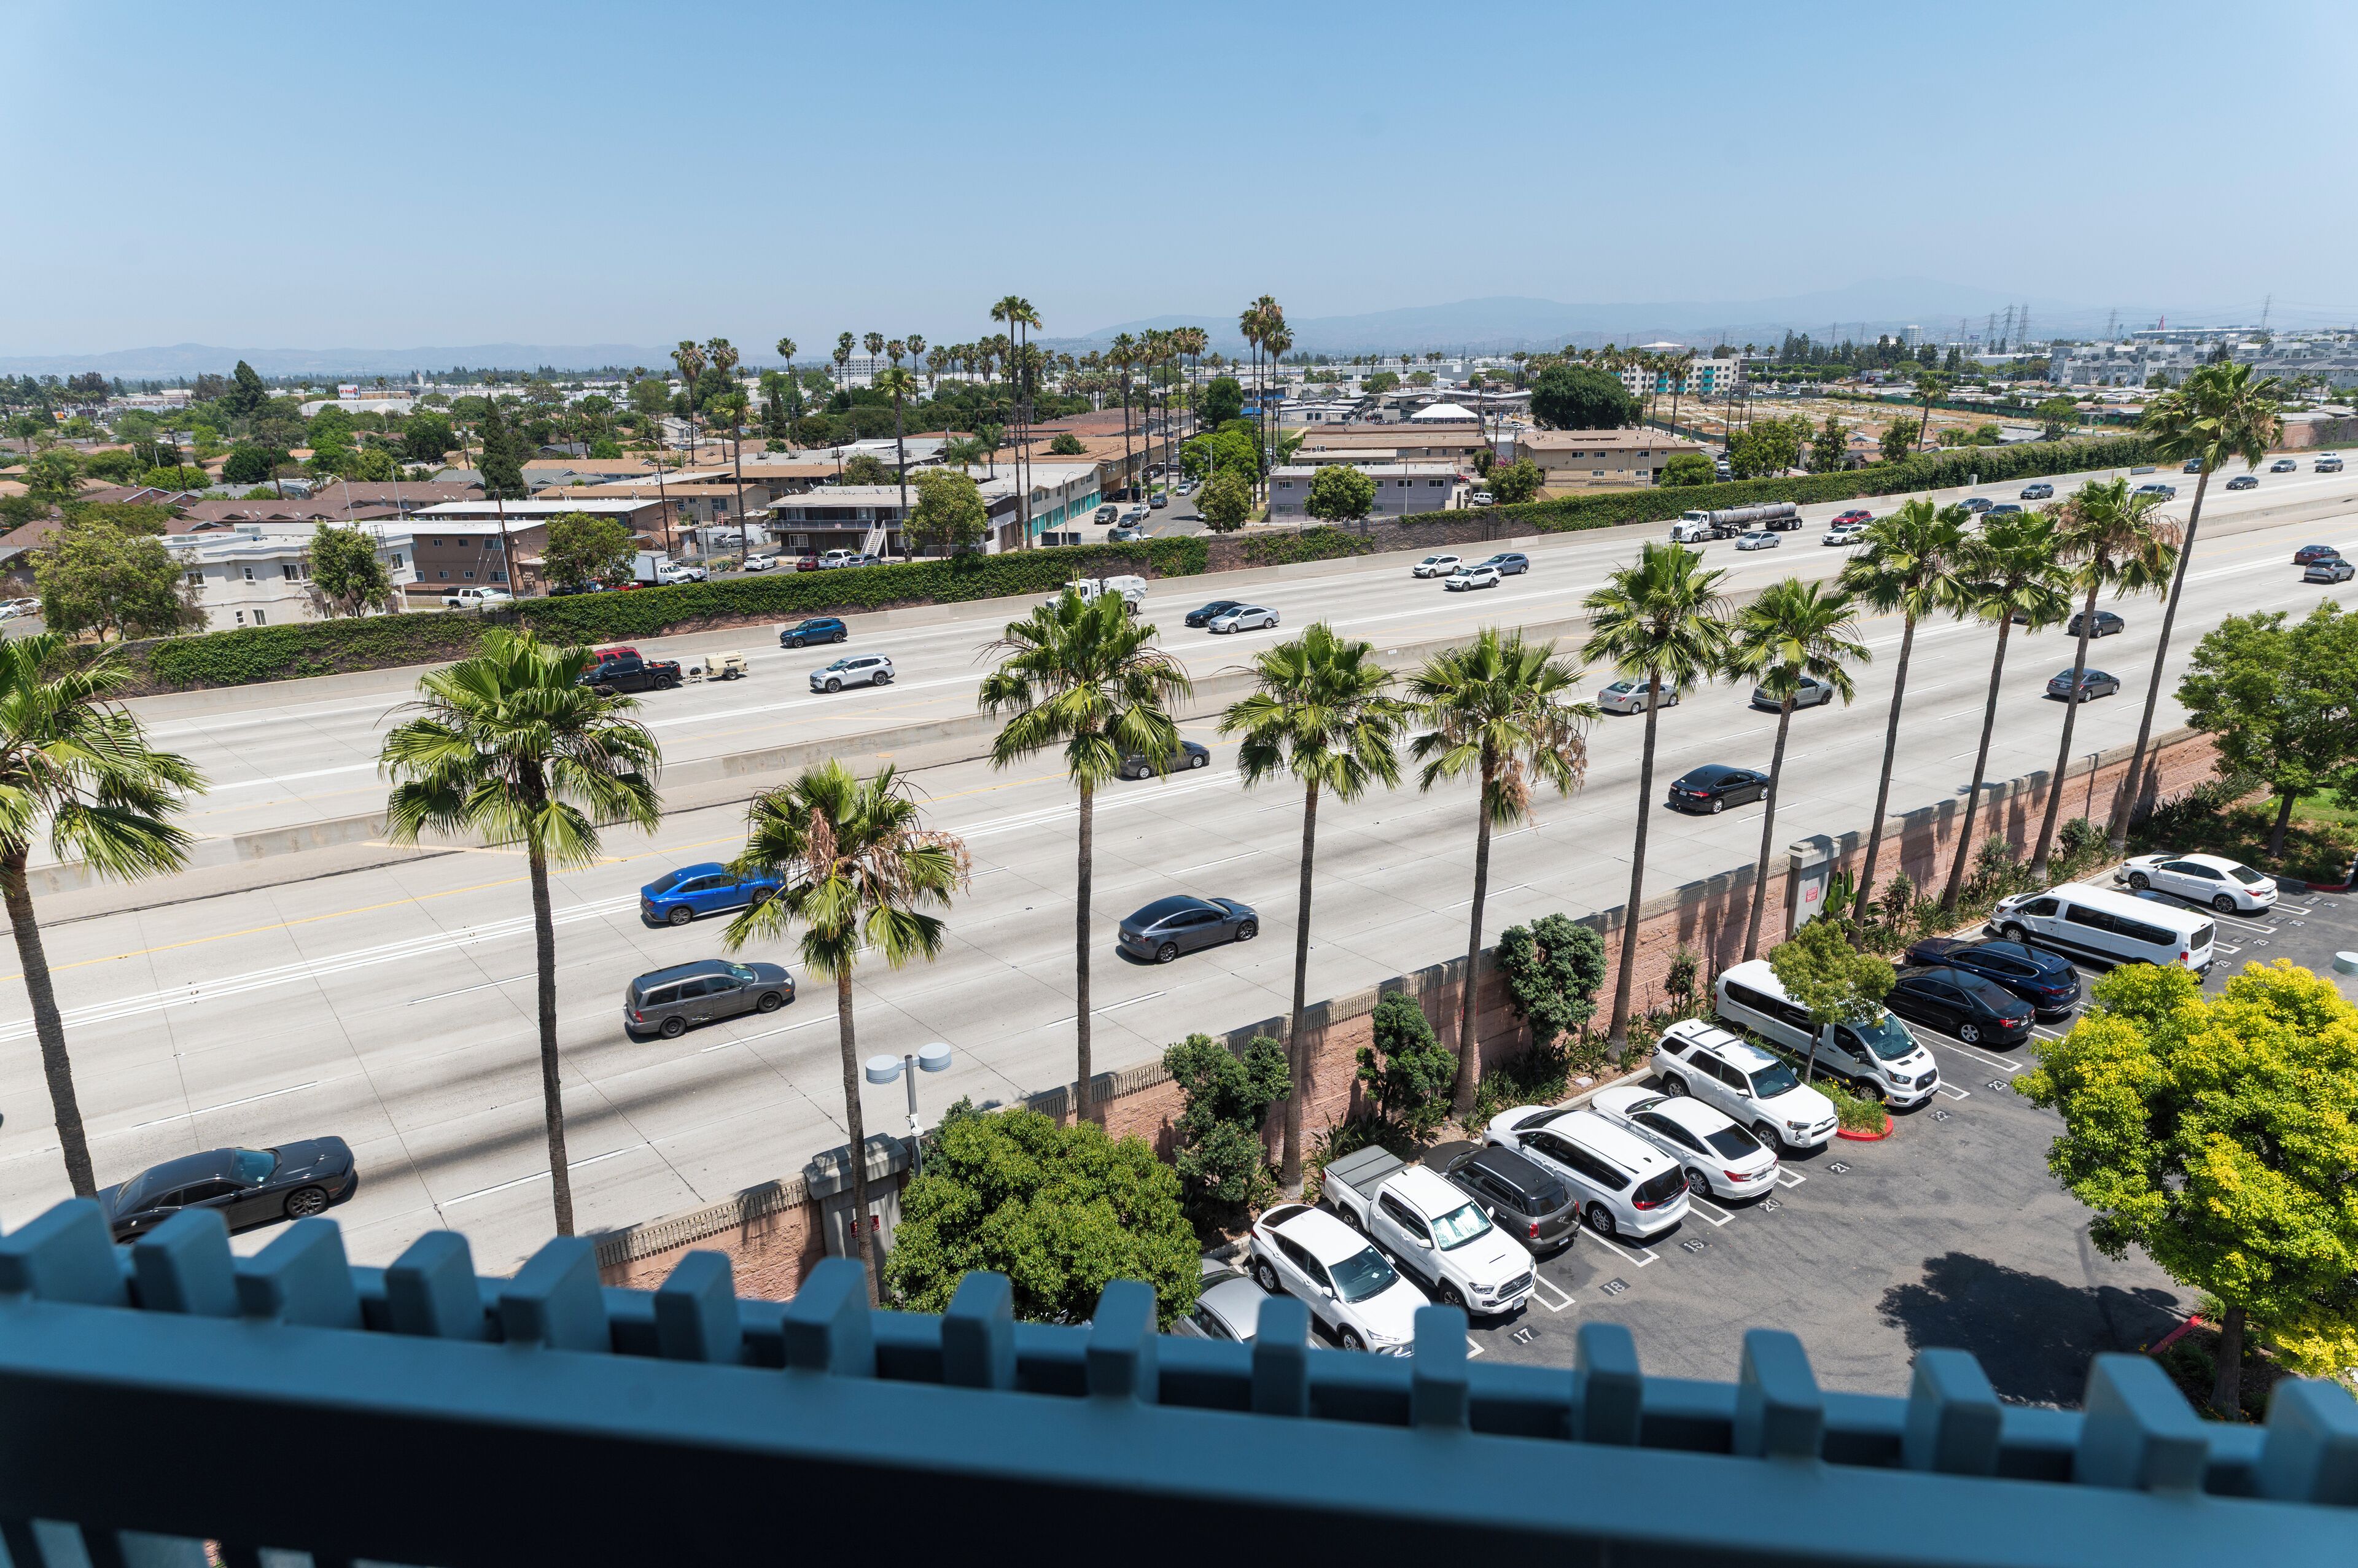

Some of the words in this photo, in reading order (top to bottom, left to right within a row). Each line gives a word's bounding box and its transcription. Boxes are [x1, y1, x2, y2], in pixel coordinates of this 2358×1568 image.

[1988, 1081, 2007, 1091] 23
[1831, 1162, 1850, 1173] 21
[1759, 1199, 1780, 1213] 20
[1684, 1240, 1704, 1252] 19
[1604, 1281, 1625, 1295] 18
[1513, 1328, 1533, 1344] 17
